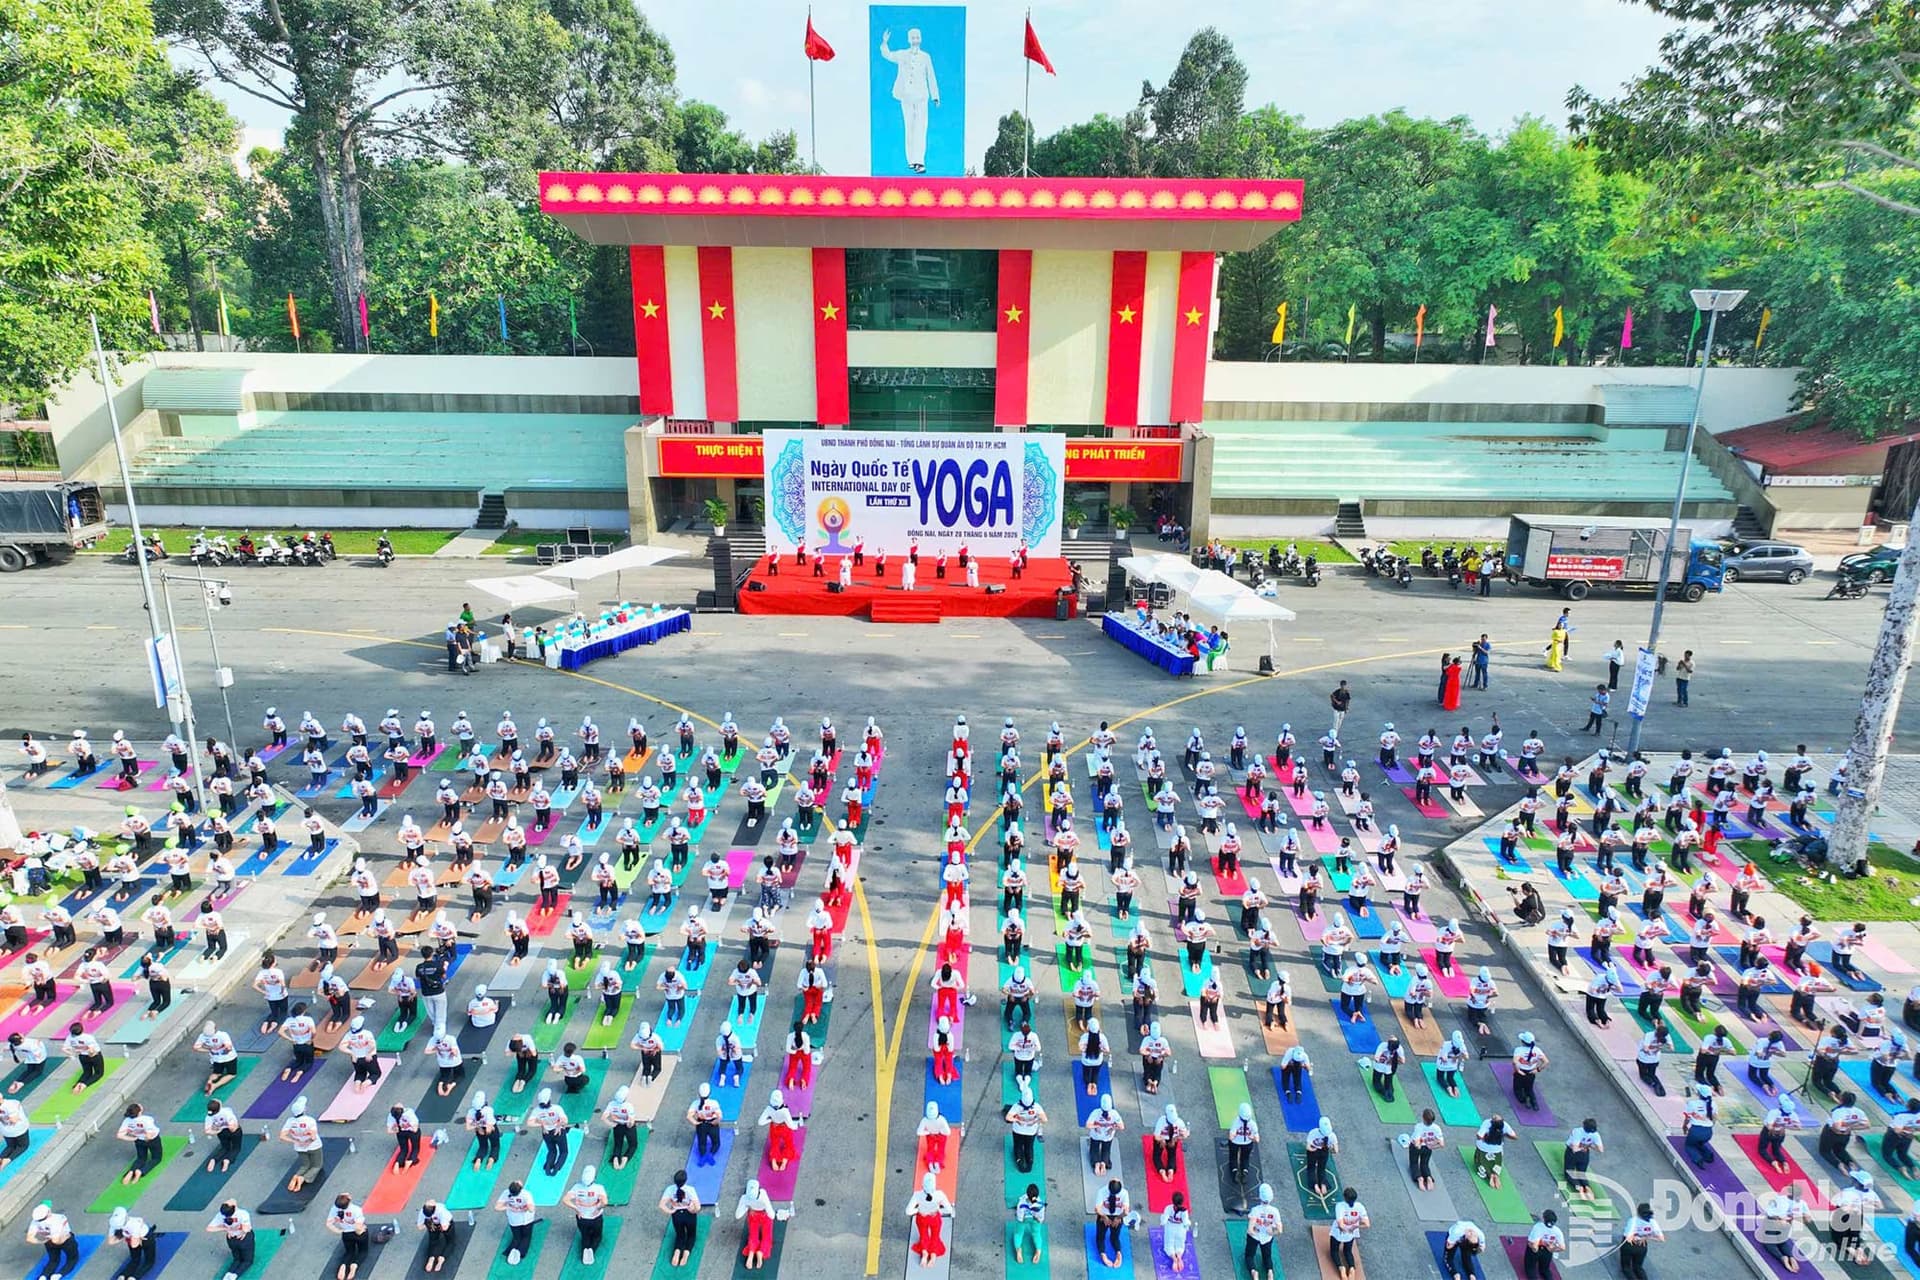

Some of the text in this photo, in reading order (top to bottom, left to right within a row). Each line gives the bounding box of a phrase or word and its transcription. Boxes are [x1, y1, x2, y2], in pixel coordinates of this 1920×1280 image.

[886, 439, 896, 448] NAI
[696, 445, 724, 458] THỰC
[727, 444, 753, 458] HIỆN
[1065, 446, 1145, 460] NG PHÁT TRIỂN
[811, 458, 911, 479] Ngày Quốc Tế
[811, 481, 911, 493] INTERNATIONAL DAY OF
[912, 458, 1014, 528] YOGA
